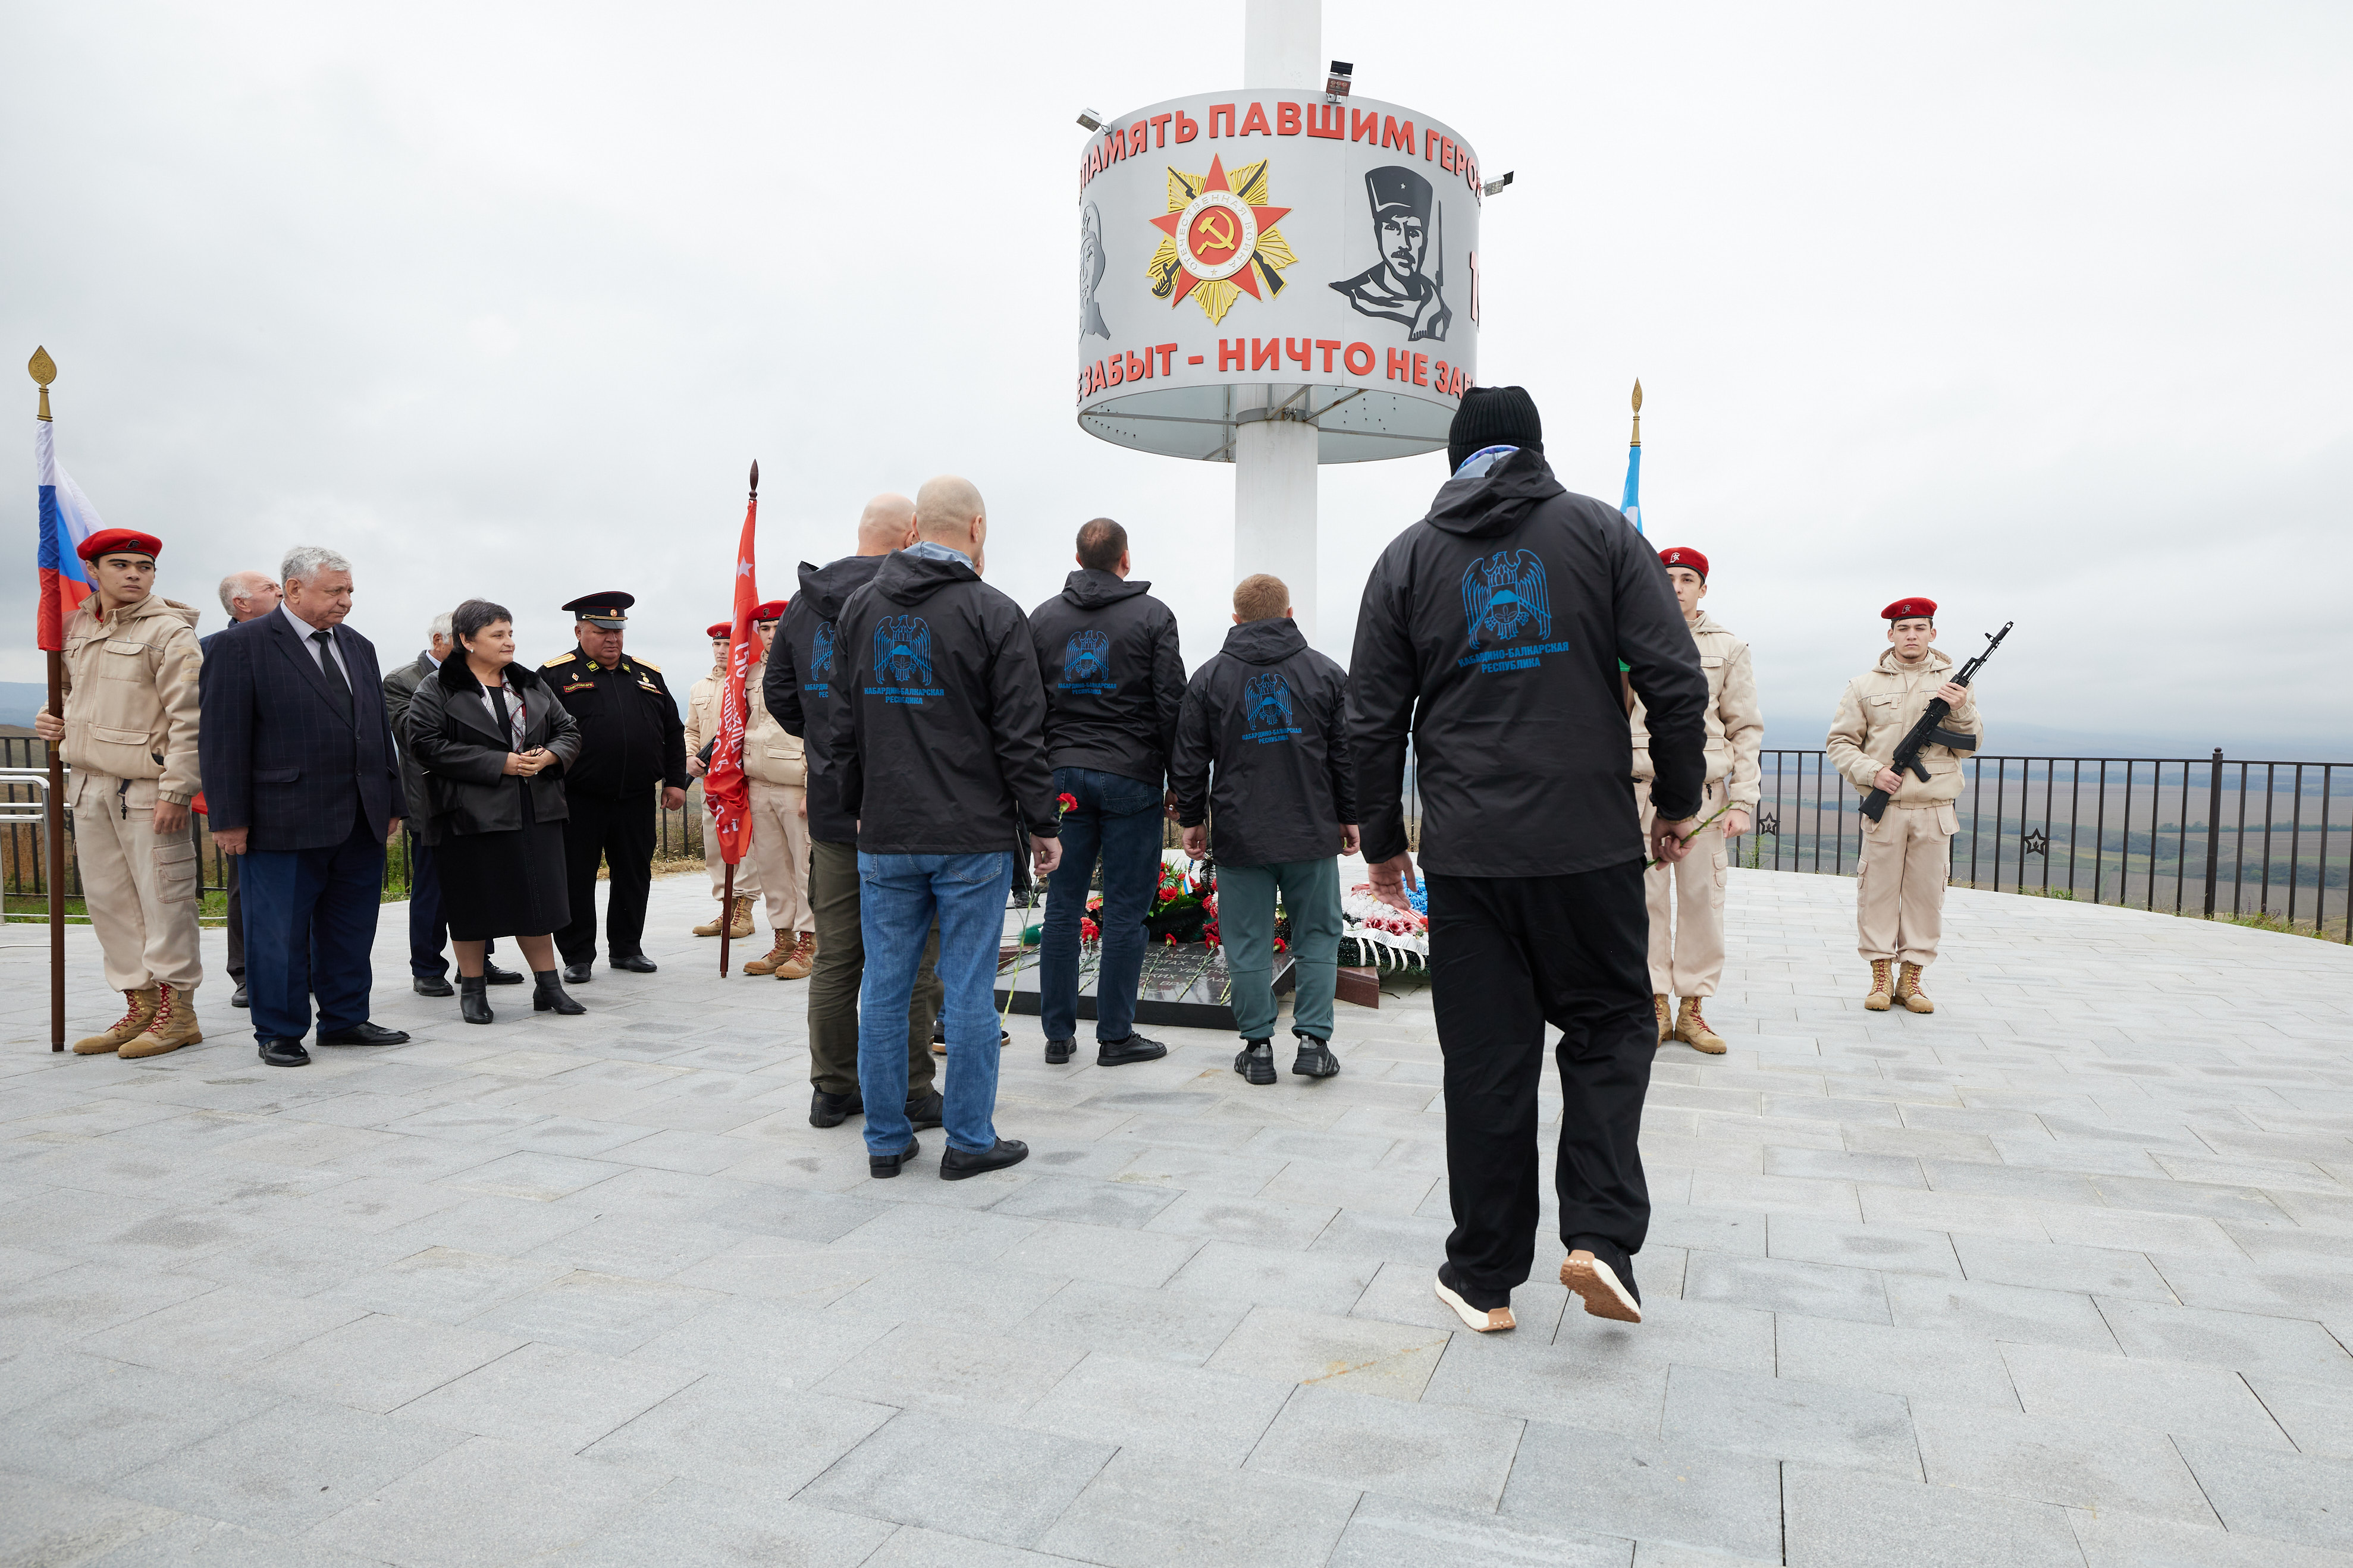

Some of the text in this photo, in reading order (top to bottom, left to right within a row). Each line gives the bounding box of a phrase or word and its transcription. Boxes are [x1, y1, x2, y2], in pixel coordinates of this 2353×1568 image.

[1081, 110, 1198, 189] ПАМЯТЬ
[1207, 102, 1416, 155] ПАВШИМ
[1179, 194, 1247, 270] ОТЕЧЕСТВЕННАЯ
[1083, 342, 1177, 397] ЗАБЫТ
[1219, 338, 1376, 376] НИЧТО
[1388, 347, 1428, 386] НЕ
[1435, 360, 1477, 400] ЗАБ
[735, 642, 749, 678] 150
[1458, 642, 1569, 667] КАБАРДИНО-БАЛКАРСКАЯ
[1482, 657, 1541, 673] РЕСПУБЛИКА
